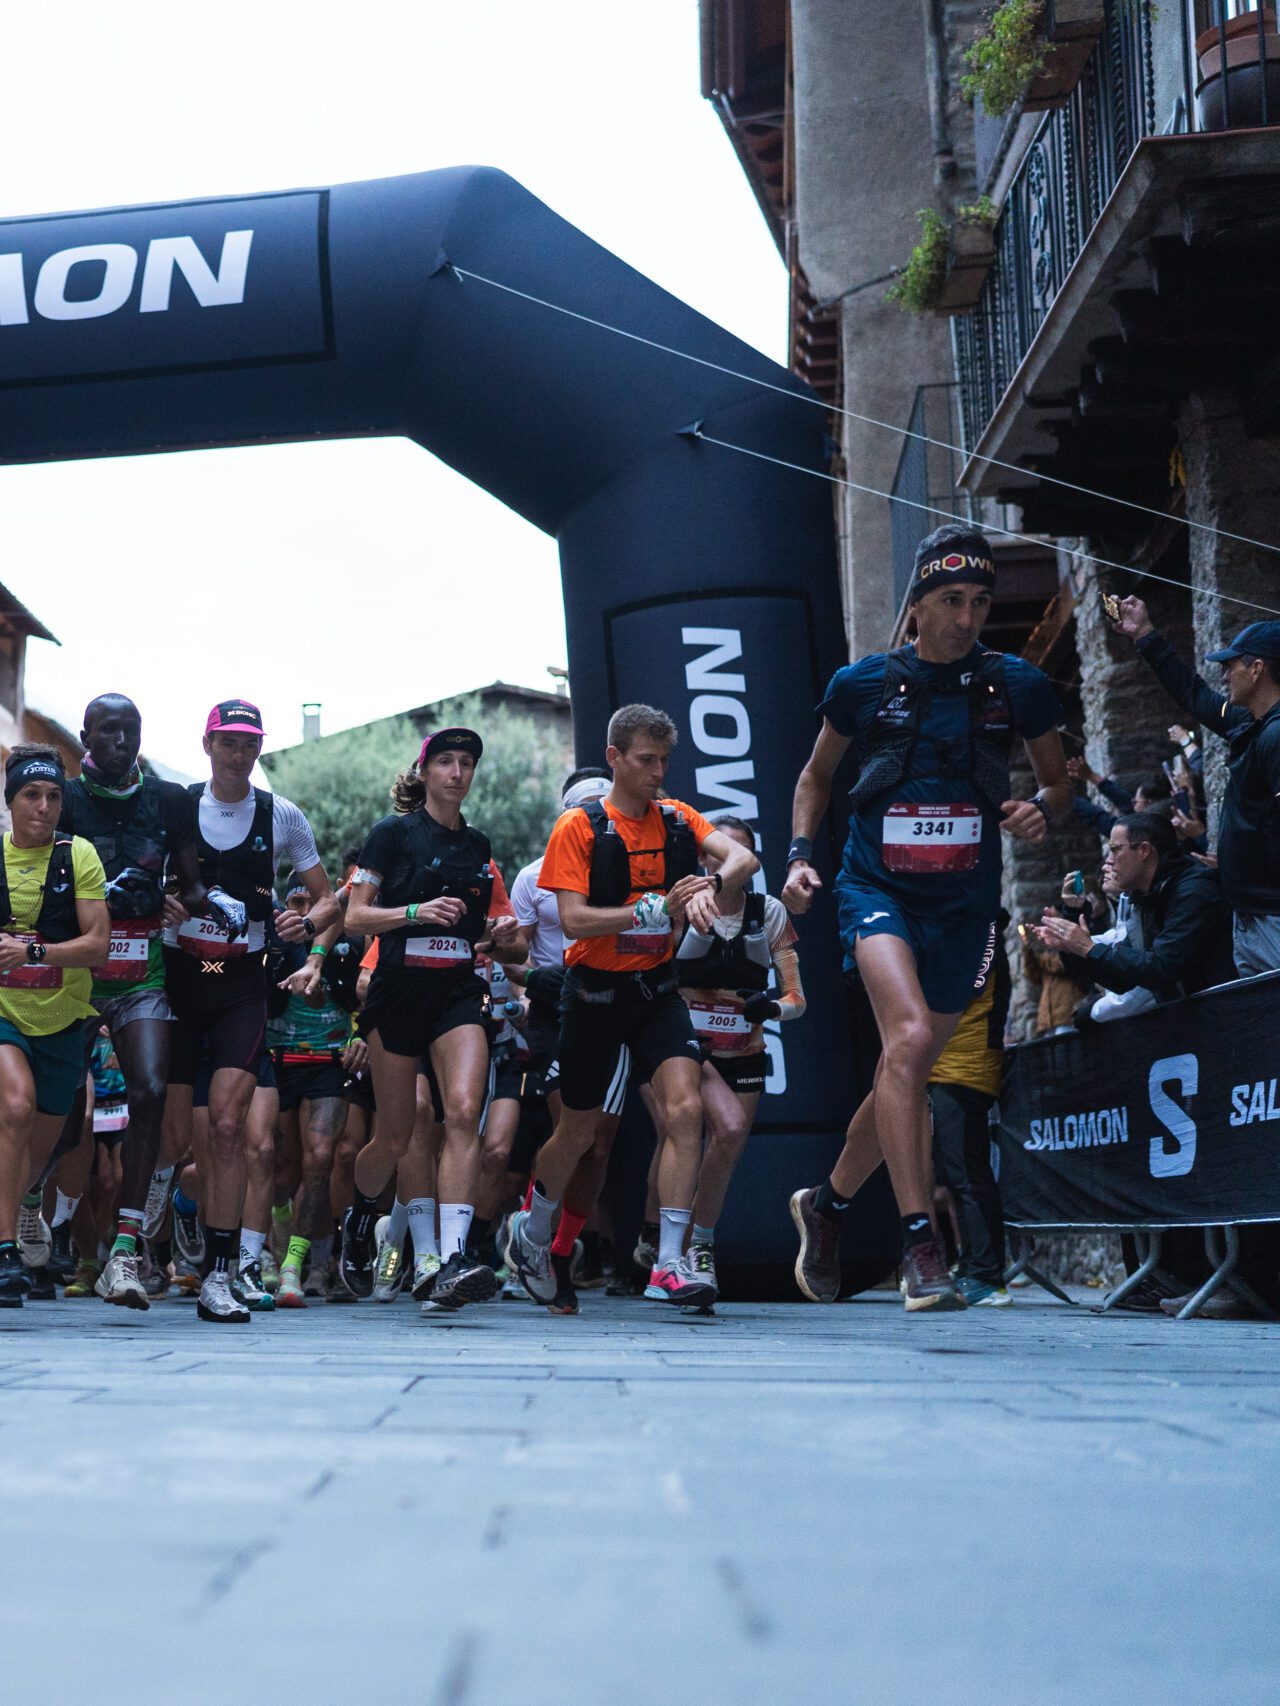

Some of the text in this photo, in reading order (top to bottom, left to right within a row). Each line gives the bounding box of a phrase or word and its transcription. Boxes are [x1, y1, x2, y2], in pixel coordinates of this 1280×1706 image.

[920, 553, 996, 579] CROWN
[912, 821, 954, 836] 3341
[108, 941, 131, 954] 002
[428, 939, 457, 951] 2024
[707, 1015, 737, 1027] 2005
[1229, 1078, 1280, 1127] SAL
[1023, 1106, 1129, 1151] SALOMON
